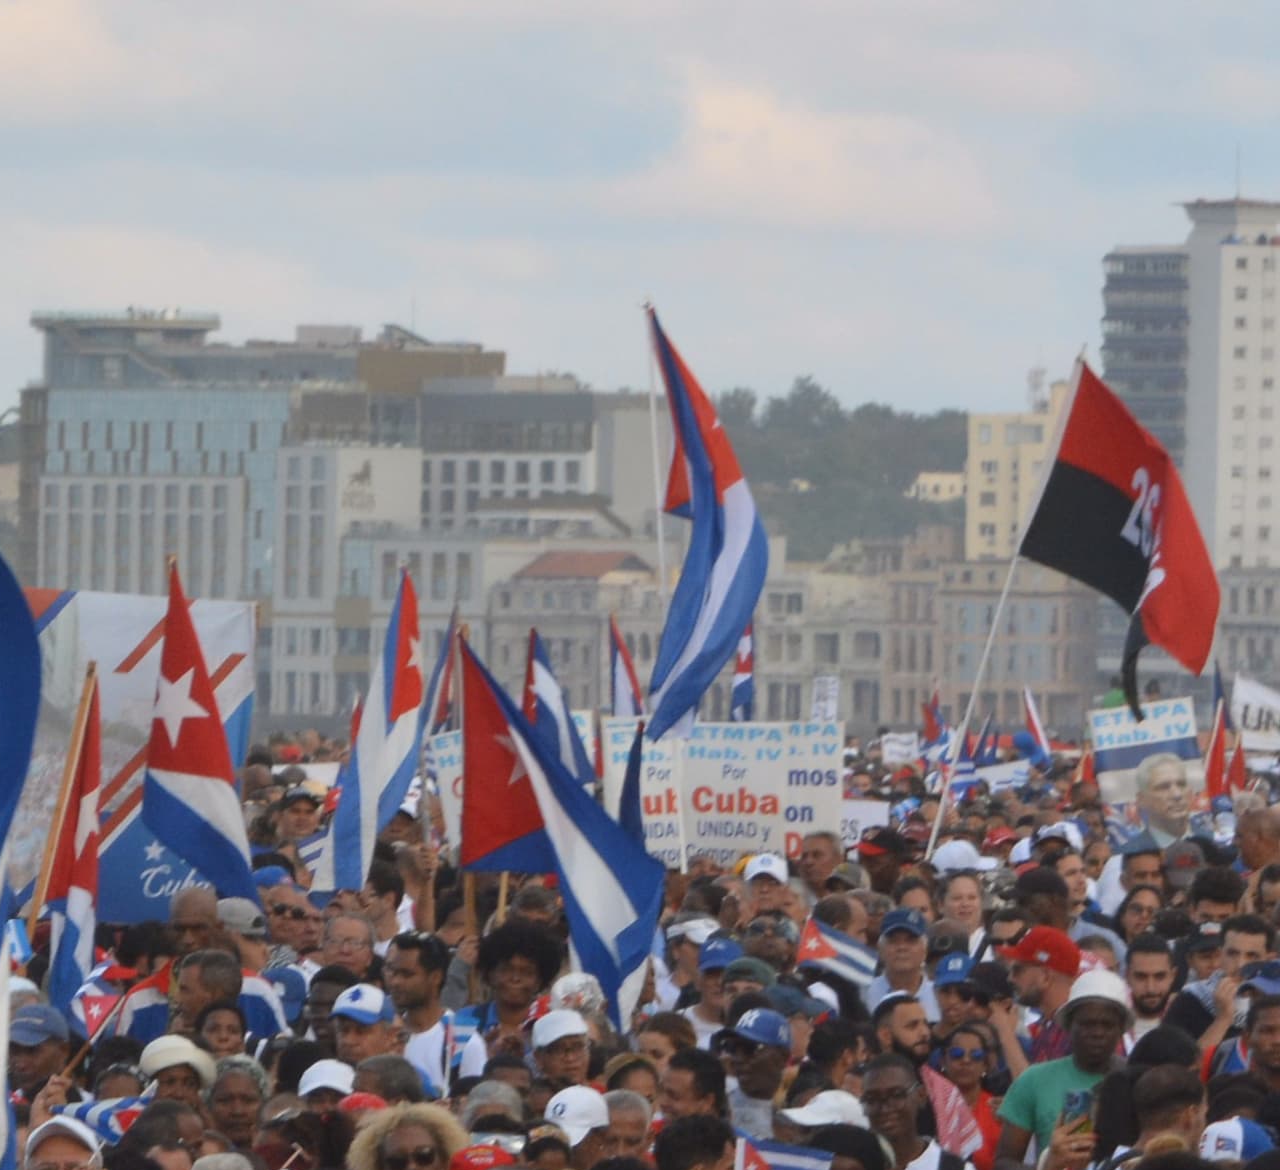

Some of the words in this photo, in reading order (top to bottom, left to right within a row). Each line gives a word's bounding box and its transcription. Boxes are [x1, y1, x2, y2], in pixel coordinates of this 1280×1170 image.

[691, 726, 783, 742] ETMPA
[722, 764, 747, 780] Por
[691, 786, 780, 815] Cuba
[697, 821, 758, 838] UNIDAD
